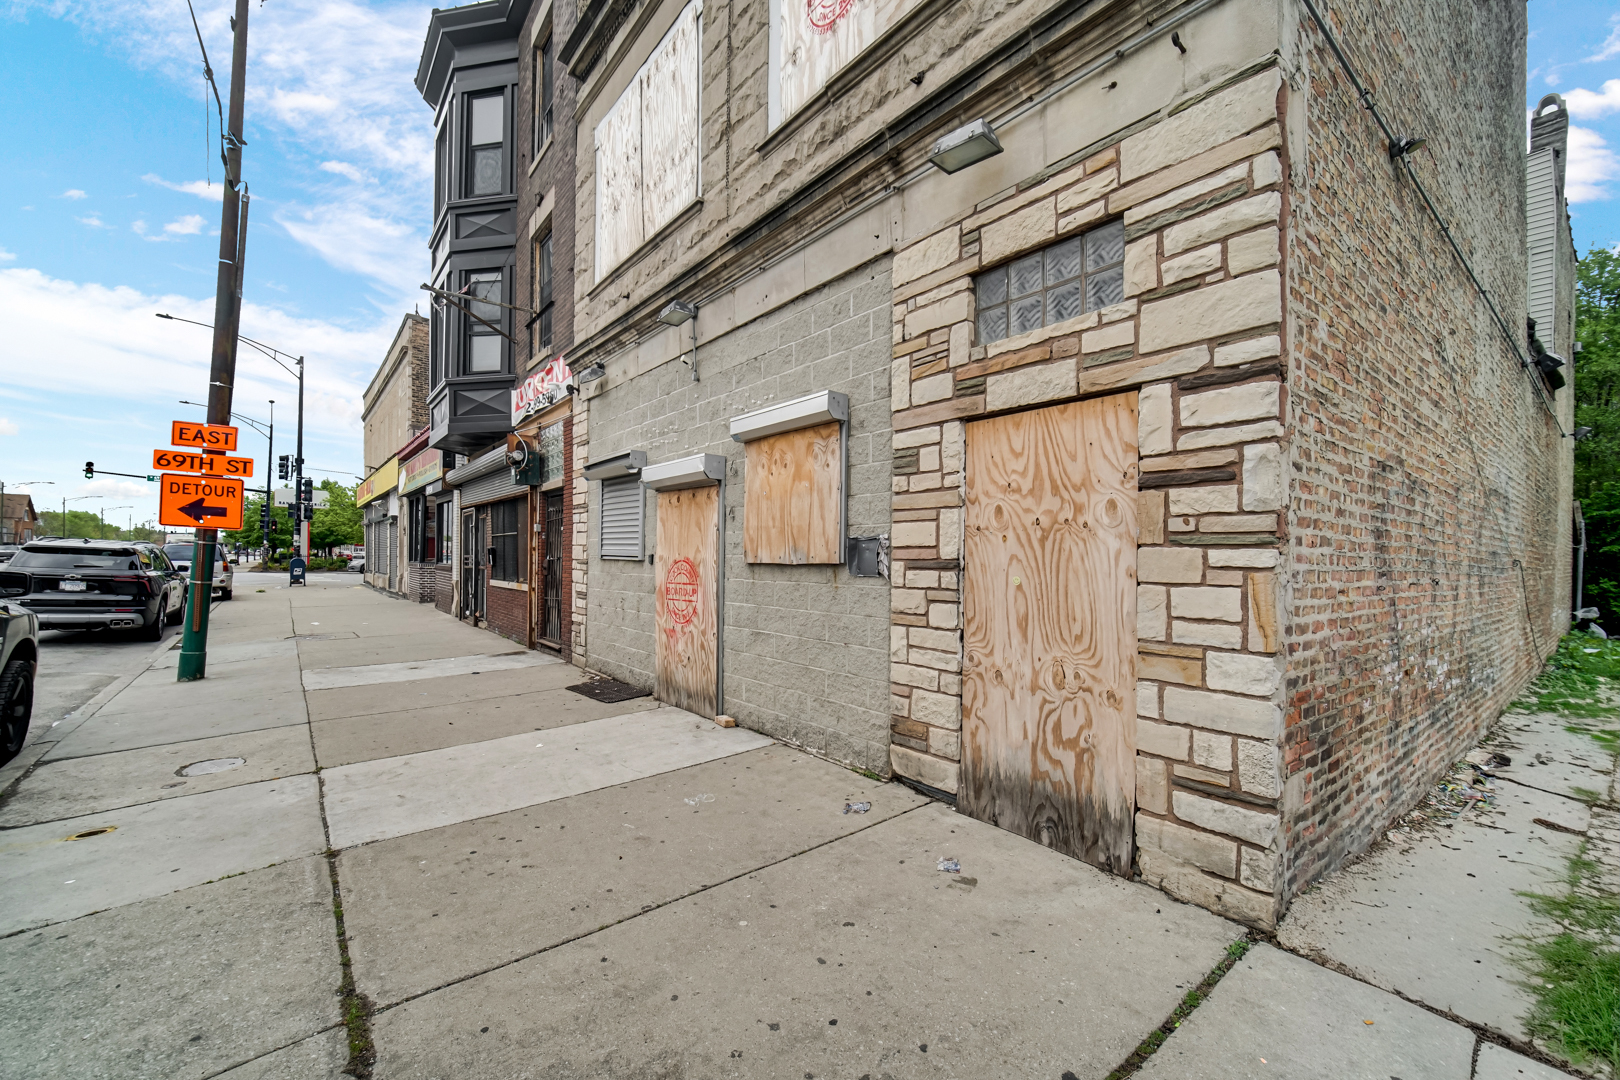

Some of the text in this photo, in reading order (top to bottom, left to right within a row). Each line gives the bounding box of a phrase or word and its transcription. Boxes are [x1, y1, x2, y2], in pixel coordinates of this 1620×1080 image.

[178, 427, 233, 445] EAST
[156, 453, 252, 474] 69TH ST
[169, 482, 236, 498] DETOUR
[666, 586, 697, 597] BOARD-UP
